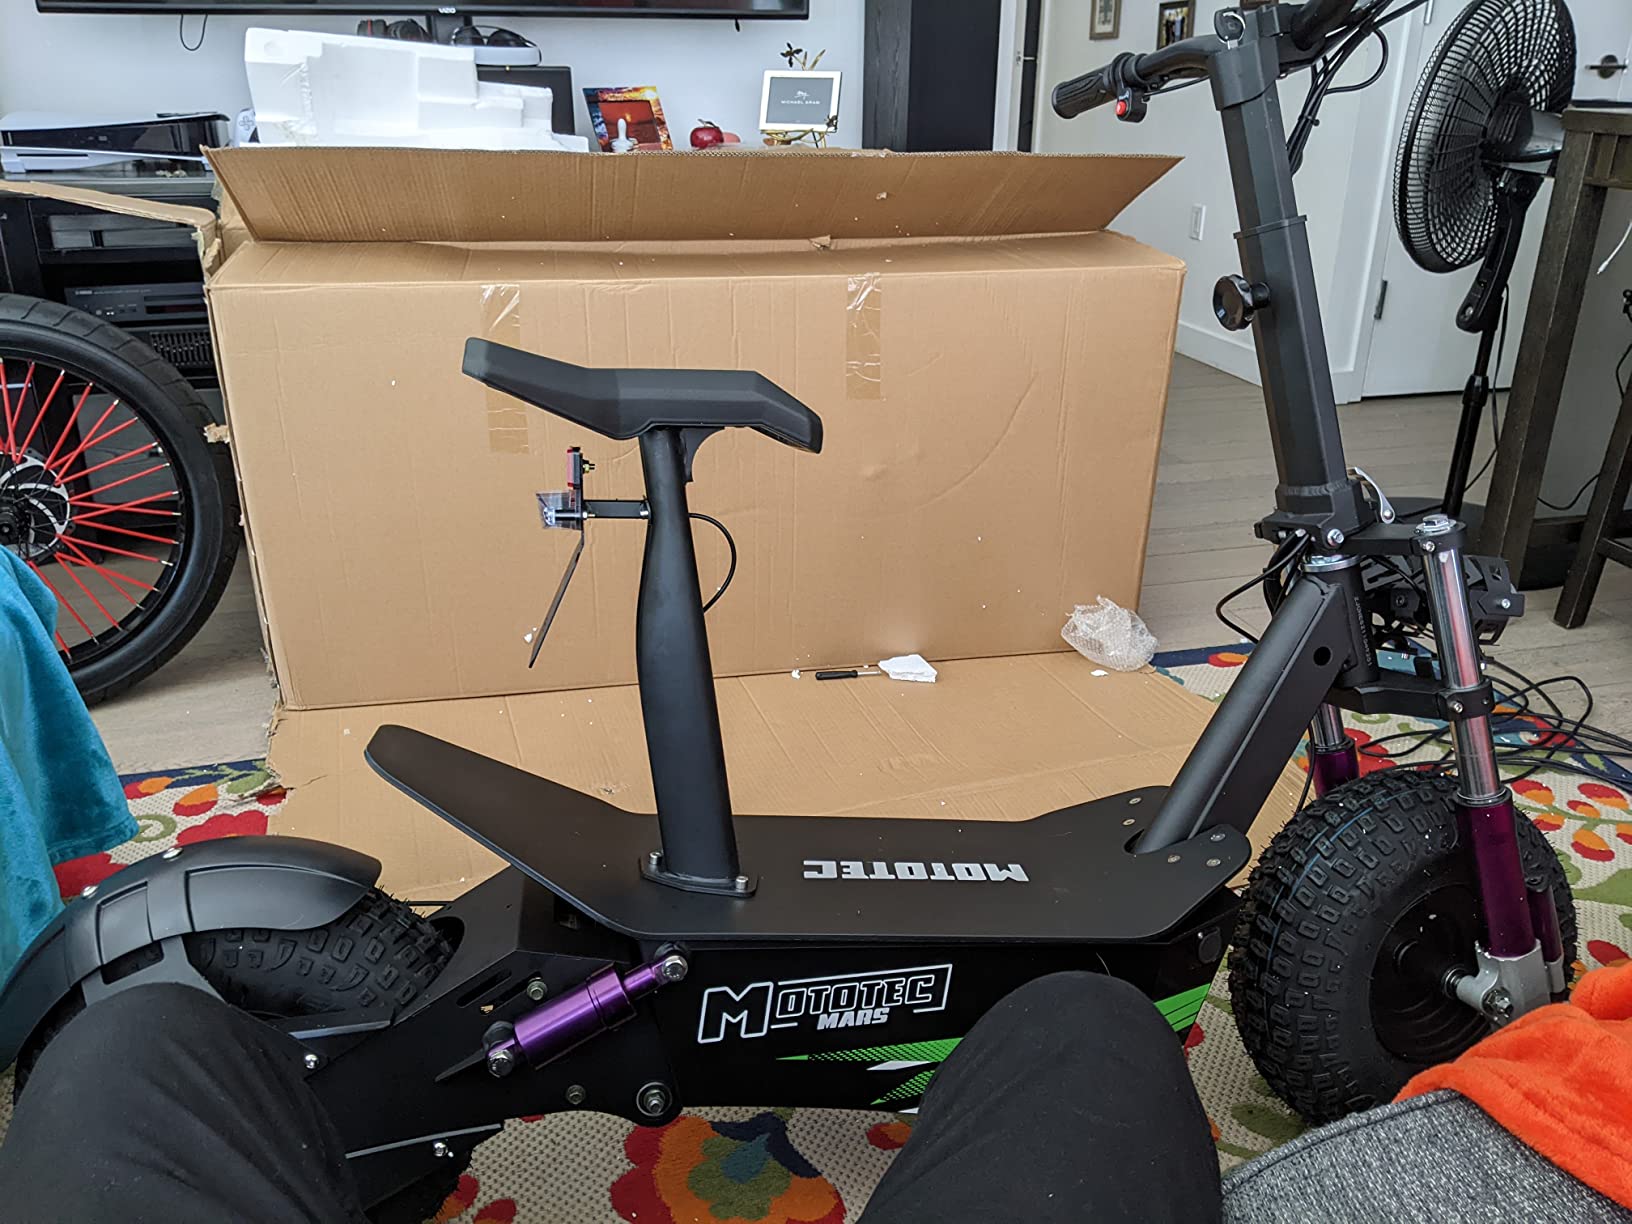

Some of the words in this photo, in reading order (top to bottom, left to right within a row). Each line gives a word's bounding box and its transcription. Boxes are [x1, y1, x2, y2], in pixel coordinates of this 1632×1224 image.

[803, 860, 1029, 882] MOTOTEC
[697, 974, 936, 1044] MOTOTEC
[816, 1007, 890, 1031] MARS
